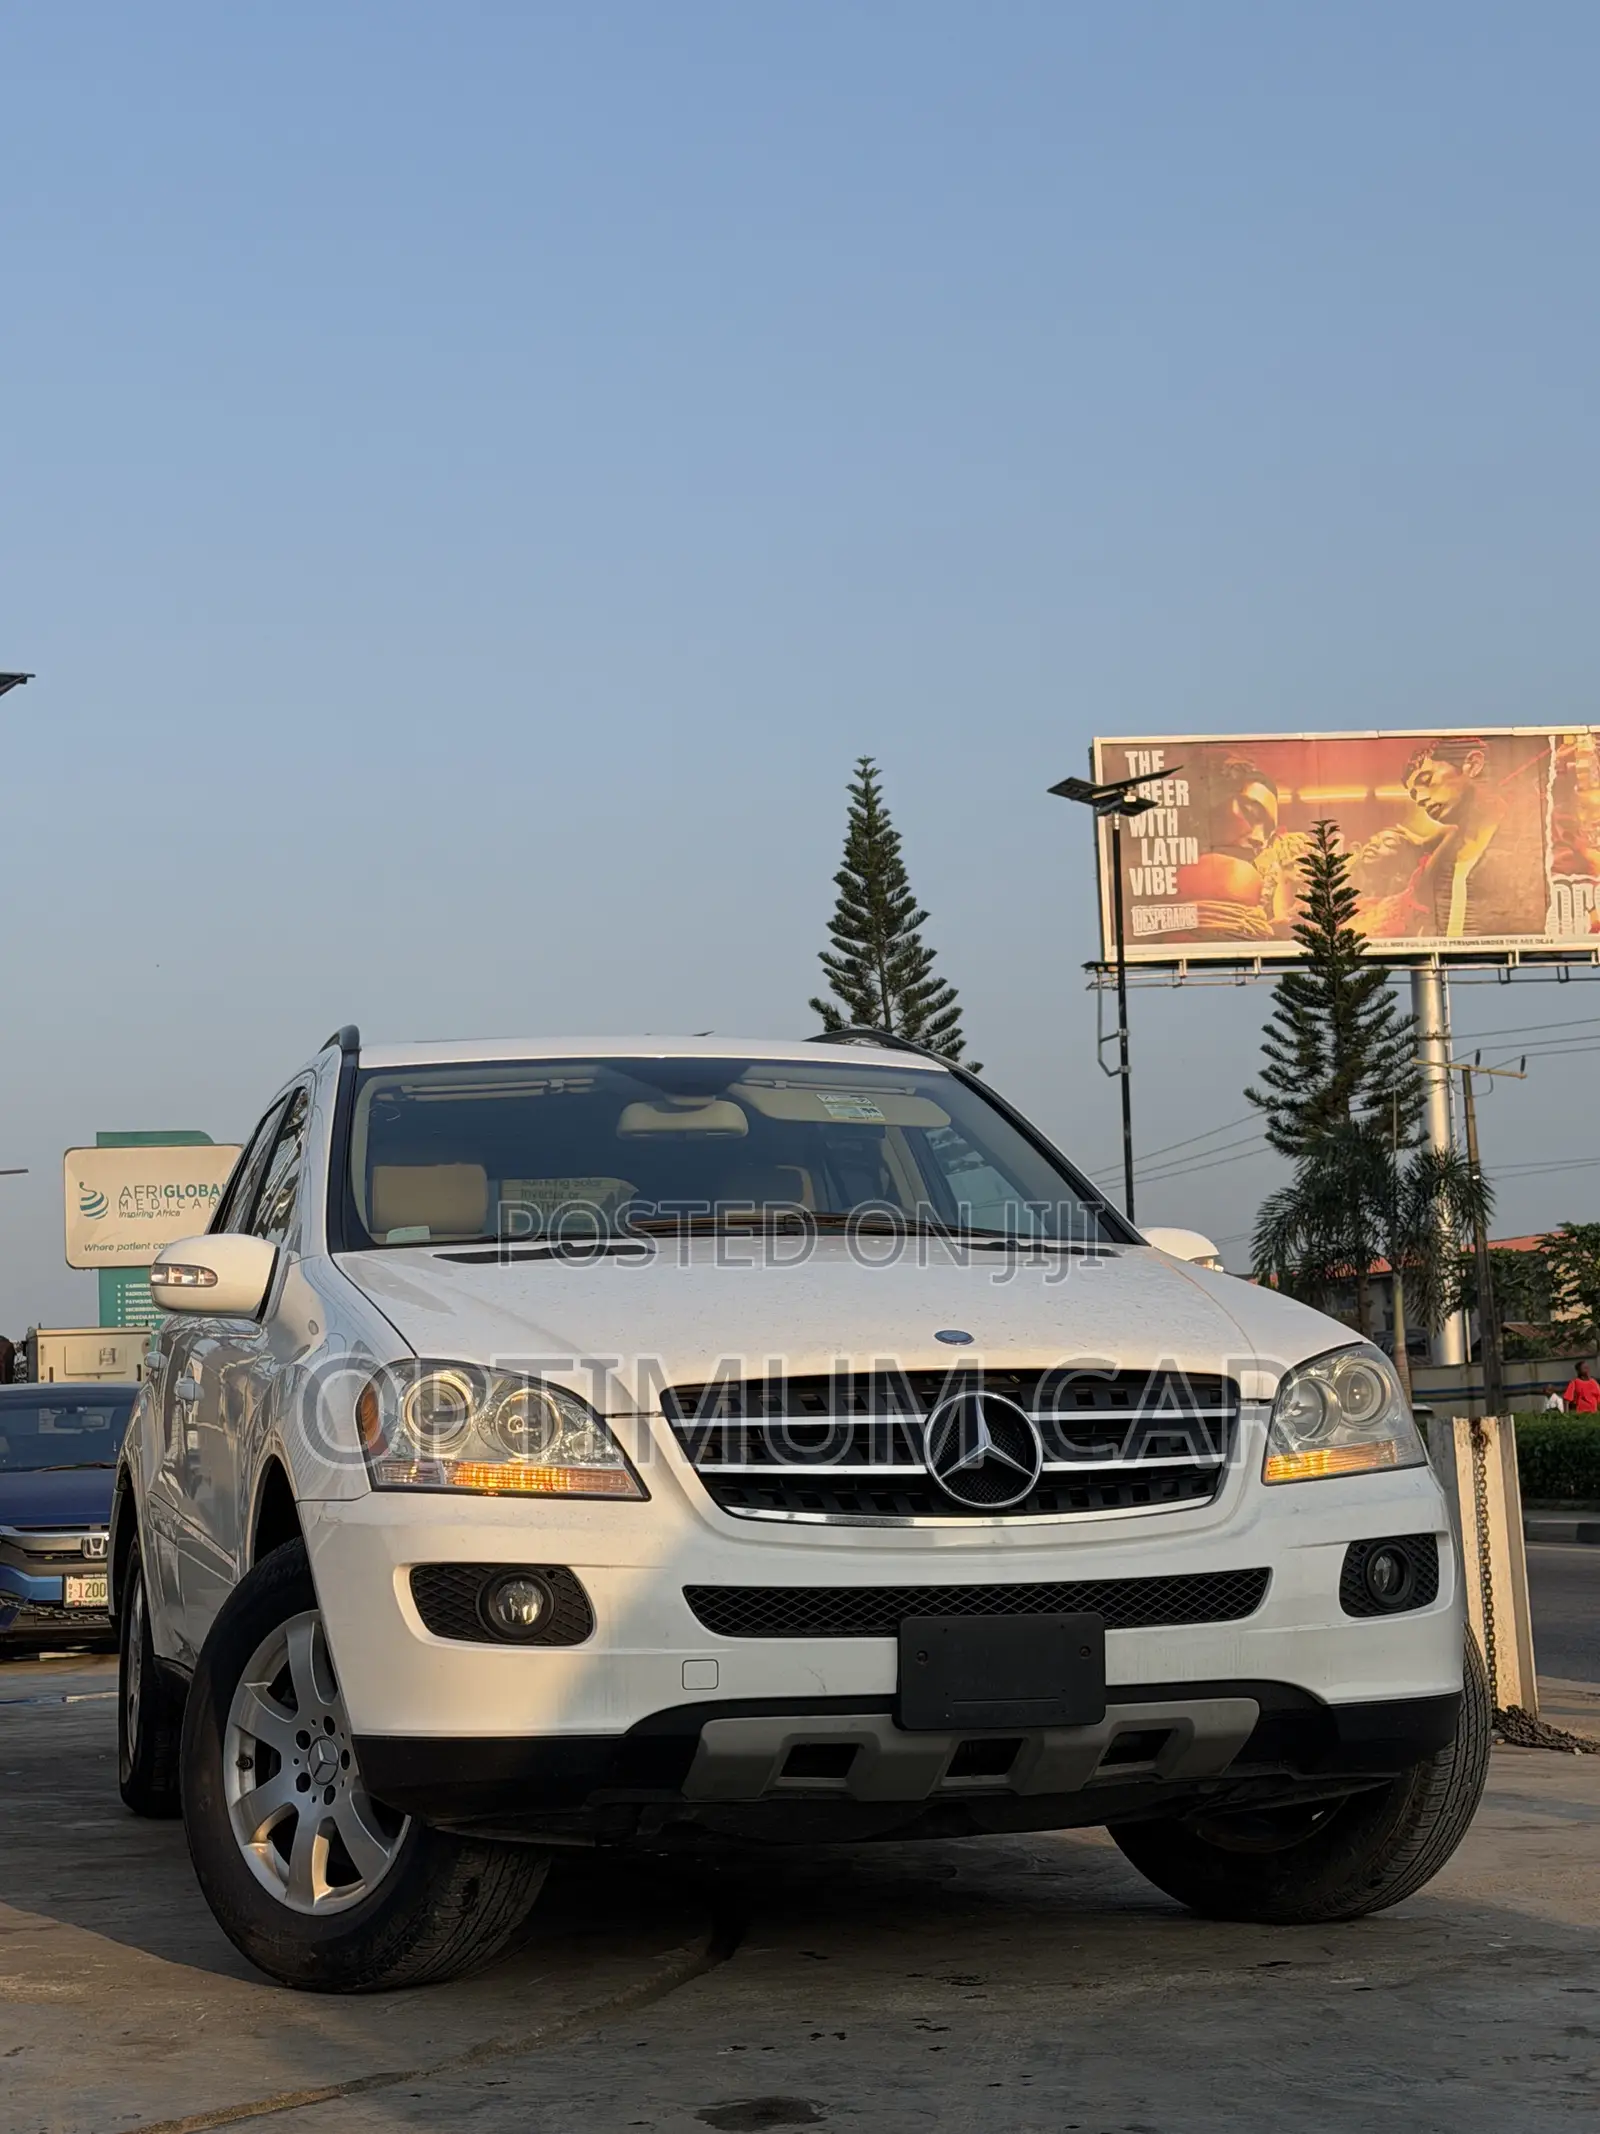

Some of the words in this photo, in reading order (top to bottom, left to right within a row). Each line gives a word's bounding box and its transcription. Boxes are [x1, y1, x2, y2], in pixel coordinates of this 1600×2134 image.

[1125, 750, 1165, 778] THE
[1137, 780, 1189, 806] BEER
[1128, 809, 1178, 838] WITH
[1141, 837, 1199, 866] LATIN
[1128, 867, 1178, 896] VIBE
[119, 1210, 154, 1220] Inspiring
[155, 1209, 181, 1218] Africa
[84, 1243, 114, 1252] Where
[117, 1242, 151, 1253] patient
